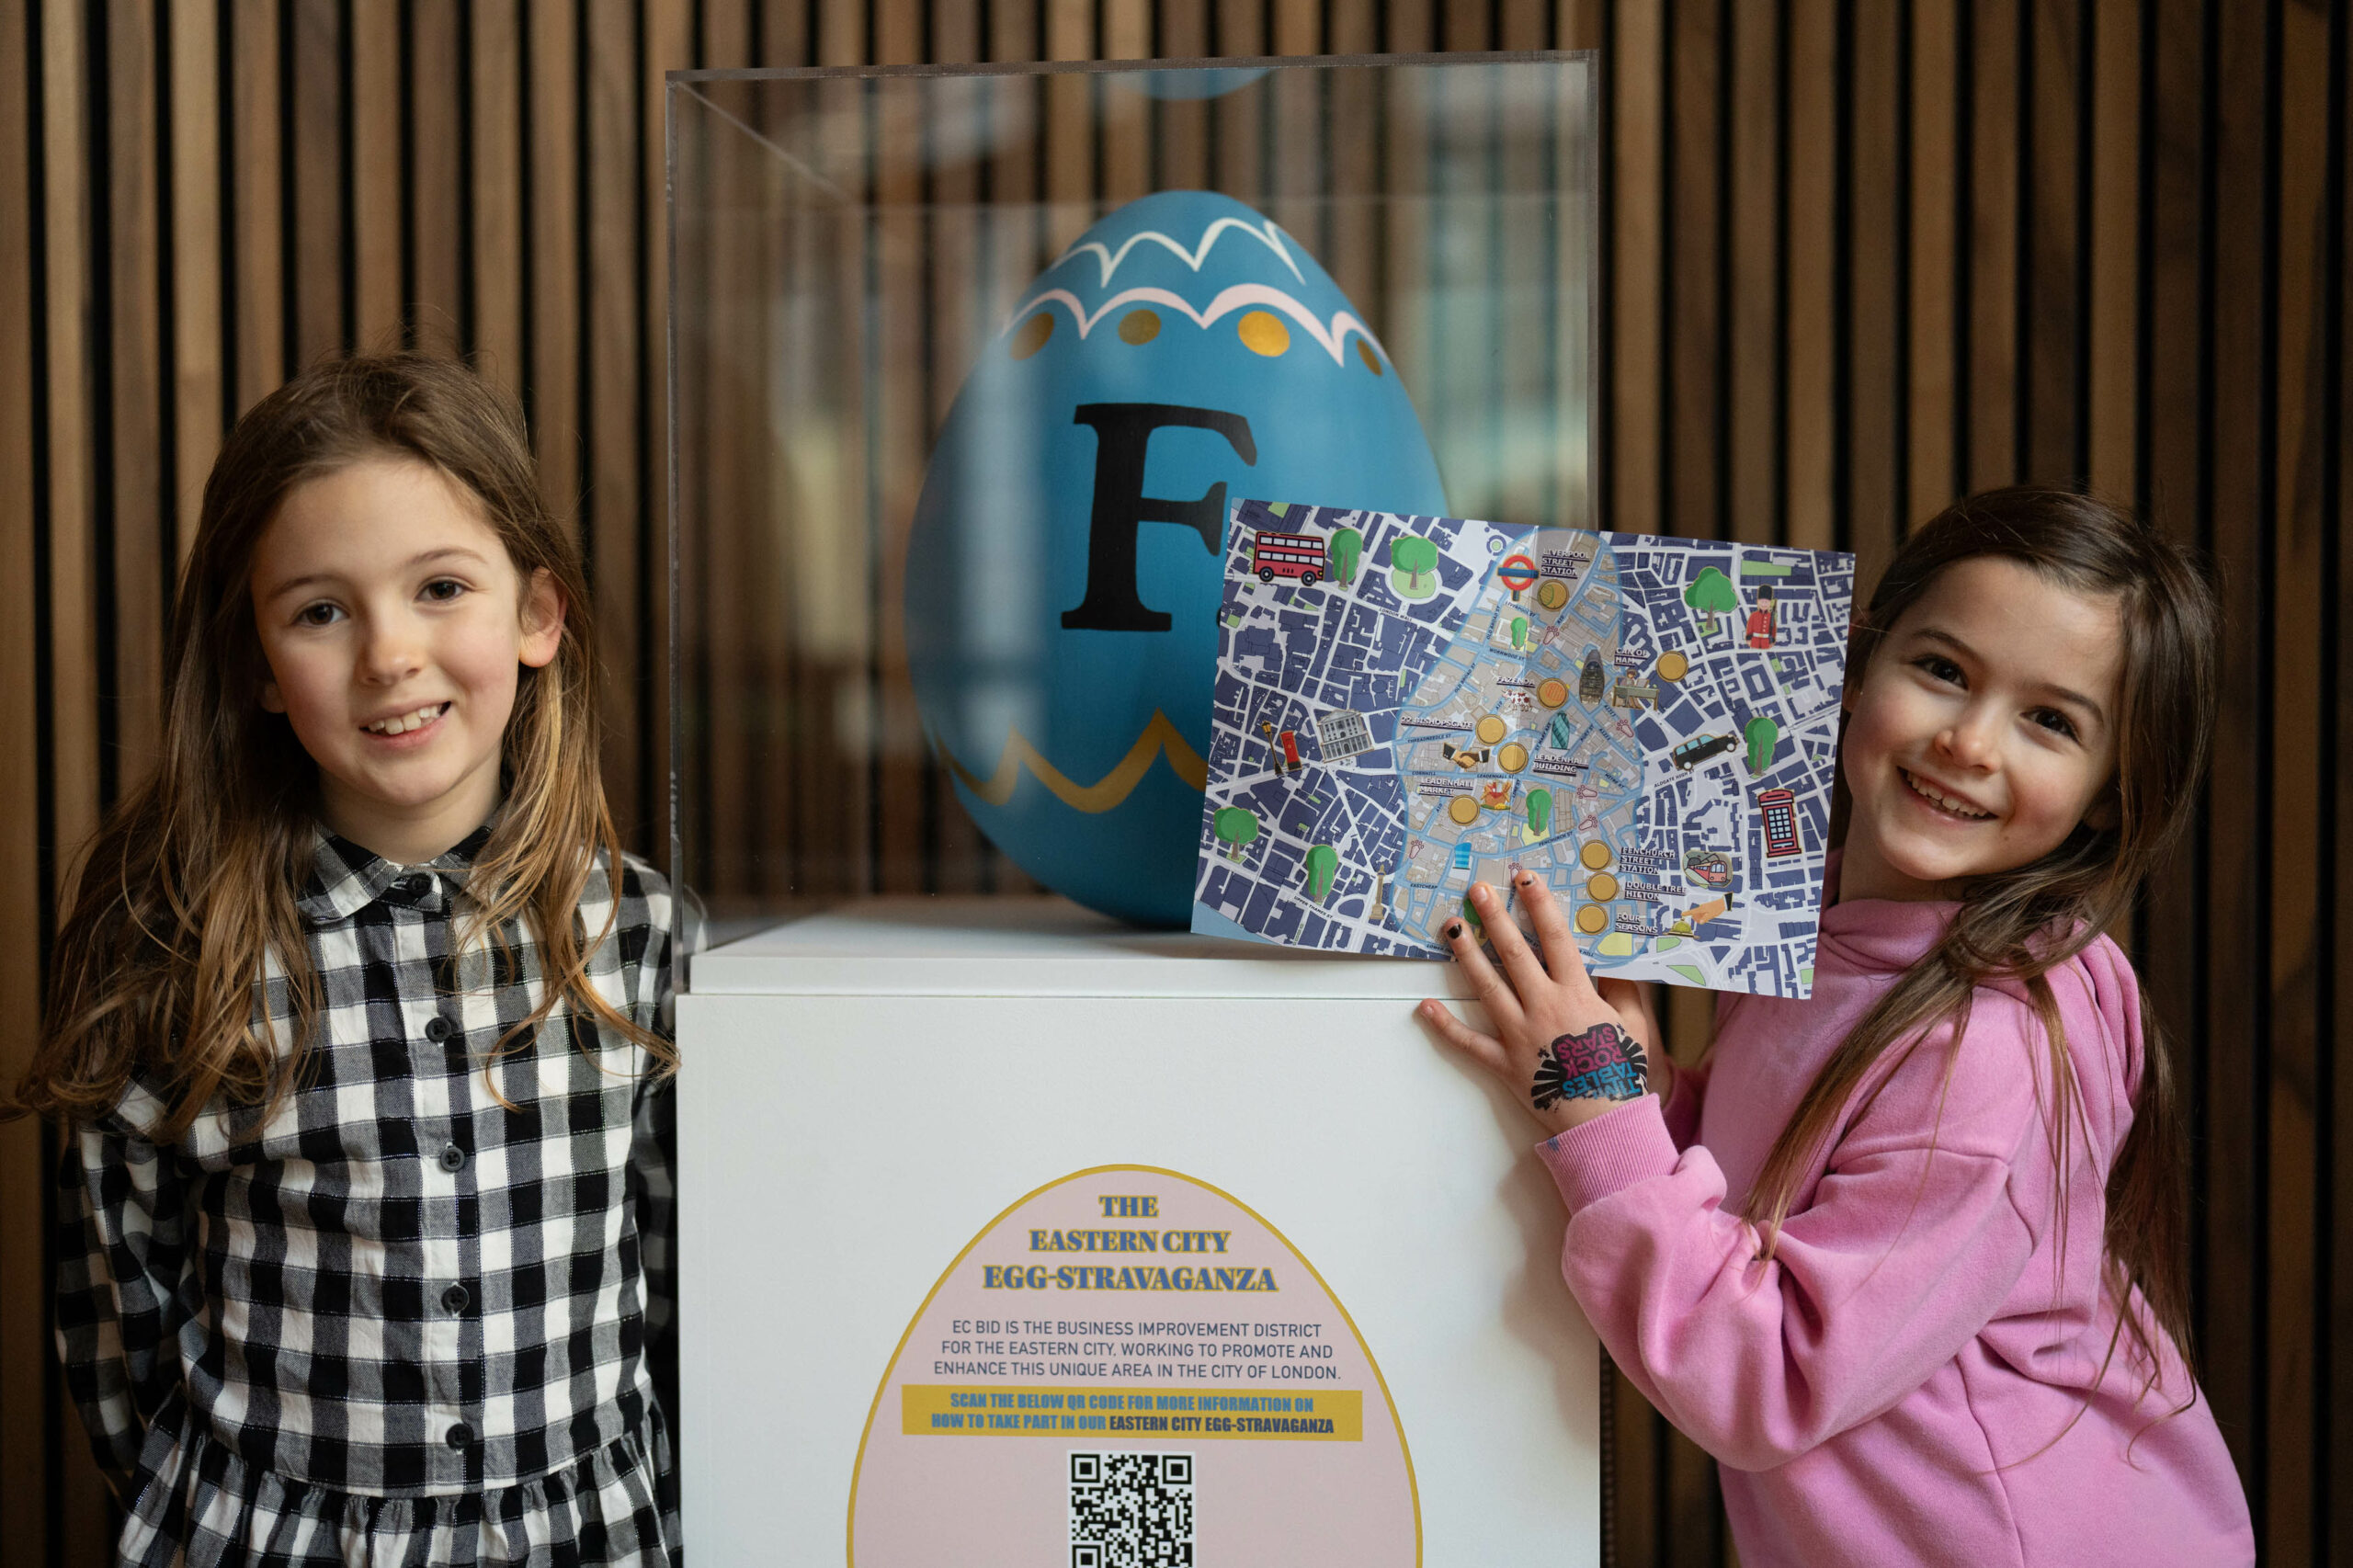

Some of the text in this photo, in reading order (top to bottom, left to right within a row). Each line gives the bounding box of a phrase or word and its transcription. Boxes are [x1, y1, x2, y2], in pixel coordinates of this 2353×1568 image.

[1061, 403, 1257, 631] F
[1543, 548, 1590, 559] LIVERPOOL
[1541, 557, 1574, 567] STREET
[1540, 566, 1577, 576] STATION
[1379, 607, 1399, 617] LONDON
[1490, 612, 1498, 630] BROAD
[1489, 648, 1518, 659] WORMWOOD
[1636, 649, 1649, 657] OF
[1615, 656, 1634, 665] HAM
[1454, 685, 1462, 693] OLD
[1461, 668, 1472, 684] BROAD
[1496, 676, 1536, 686] FAZENDA
[1415, 717, 1473, 728] BISHOPSGATE
[1407, 734, 1445, 744] THREADNEEDLE
[1538, 732, 1547, 744] MARY
[1534, 754, 1588, 765] LEADENHALL
[1533, 762, 1577, 773] BUILDING
[1421, 778, 1473, 788] LEADENHALL
[1654, 775, 1675, 788] ALDGATE
[1676, 771, 1688, 779] HIGH
[1419, 786, 1454, 795] MARKET
[1539, 834, 1566, 846] FENCHURCH
[1621, 846, 1676, 858] FENCHURCH
[1620, 856, 1654, 865] STREET
[1620, 864, 1660, 874] STATION
[1626, 881, 1687, 893] DOUBLE TREE
[1625, 891, 1660, 901] HILTON
[1294, 896, 1309, 906] UPPER
[1309, 904, 1327, 915] THAMES
[1616, 912, 1641, 922] FOUR
[1615, 923, 1659, 934] SEASONS
[1557, 1026, 1616, 1060] STARS
[1563, 1041, 1629, 1079] ROCK
[1563, 1061, 1638, 1098] TABLES
[1098, 1195, 1159, 1218] THE
[1029, 1229, 1231, 1254] EASTERN CITY
[983, 1265, 1279, 1292] EGG-STRAVAGANZA
[953, 1320, 1322, 1337] EC BID IS THE BUSINESS IMPROVEMENT DISTRICT
[942, 1340, 971, 1354] FOR
[975, 1341, 1004, 1355] THE
[1009, 1342, 1077, 1356] EASTERN
[1121, 1343, 1193, 1357] WORKING
[1199, 1344, 1217, 1357] TO
[1222, 1344, 1295, 1358] PROMOTE
[1300, 1345, 1332, 1358] AND
[935, 1361, 1341, 1380] ENHANCE THIS UNIQUE AREA IN THE CITY OF LONDON.
[950, 1392, 1313, 1413] SCAN THE BELOW QR CODE FOR MORE INFORMATION ON
[931, 1413, 1334, 1434] HOW TO TAKE PART IN OUR EASTERN CITY EGG-STRAVAGANZA
